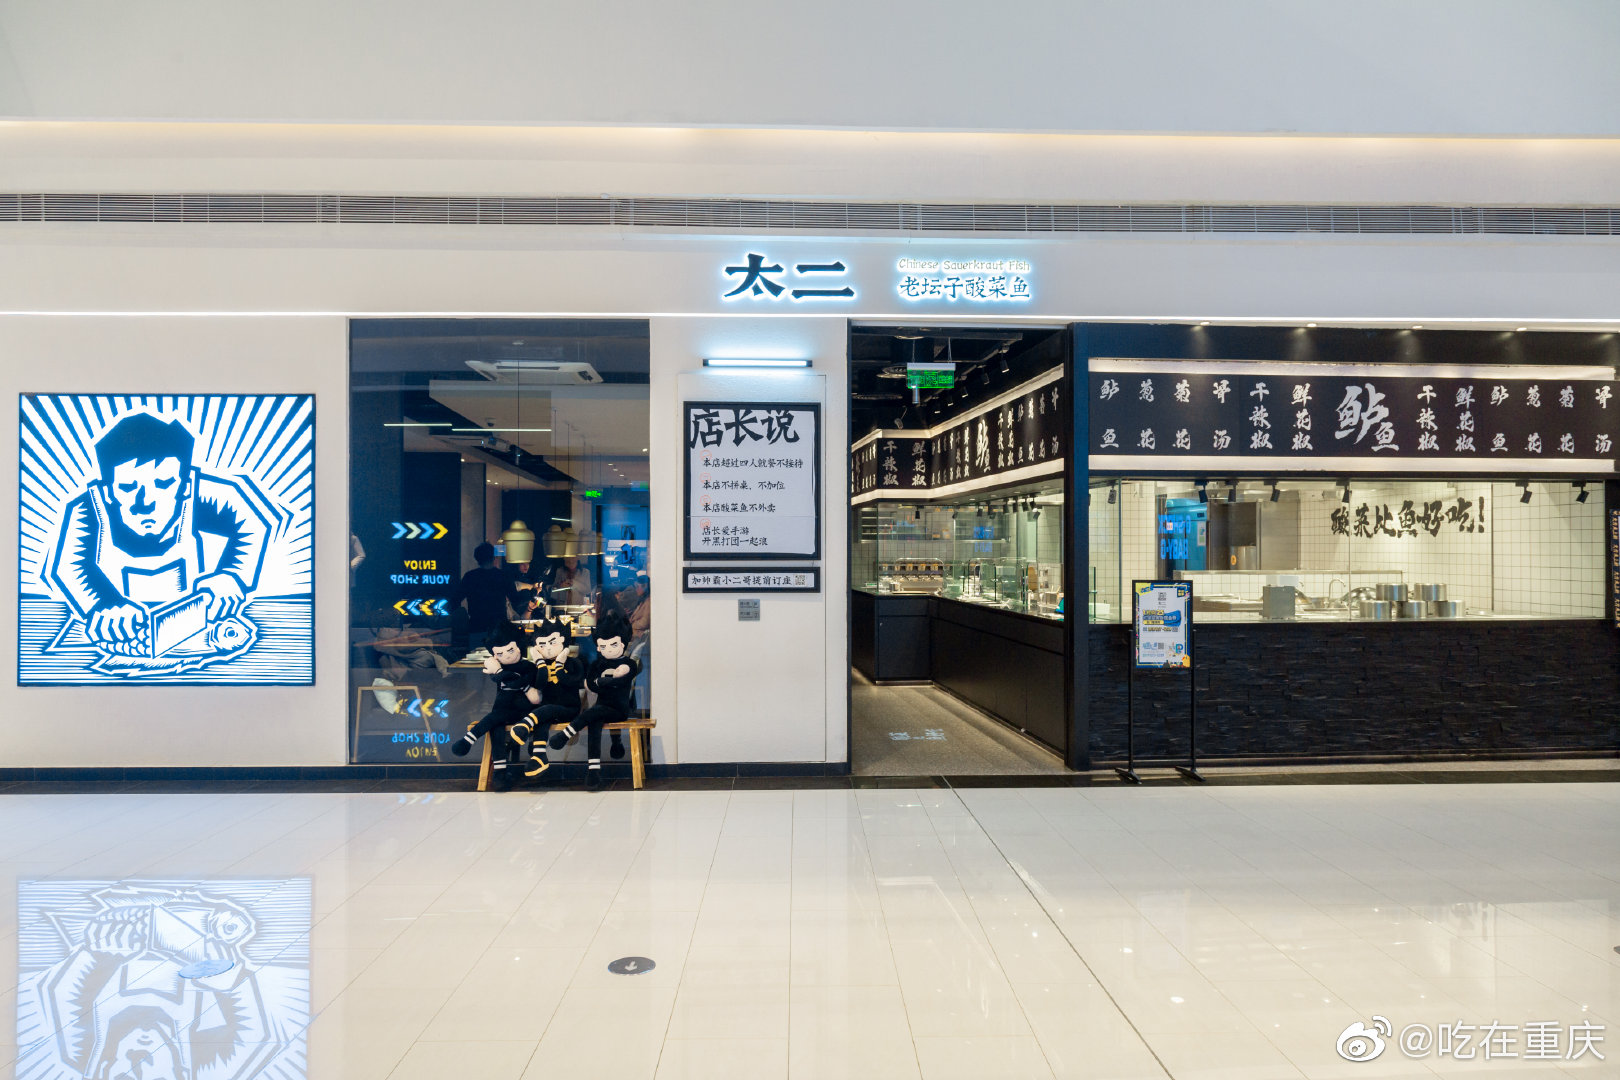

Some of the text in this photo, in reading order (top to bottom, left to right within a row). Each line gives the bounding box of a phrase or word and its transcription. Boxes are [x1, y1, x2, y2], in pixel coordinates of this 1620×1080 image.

[724, 253, 855, 299] 太二
[899, 258, 1030, 271] Chinese Sauerkraut Fish
[900, 275, 1030, 299] 老坛子酸菜鱼
[1249, 382, 1273, 450] 干辣椒
[1291, 382, 1314, 451] 鲜花椒
[1416, 385, 1440, 451] 干辣椒
[1454, 385, 1476, 452] 鲜花椒
[690, 408, 801, 449] 店长说
[702, 458, 804, 469] 本店超过四人就餐不接待
[702, 503, 776, 513] 本店酸菜鱼不外卖
[702, 526, 750, 535] 店长爱手游
[702, 537, 768, 547] 开黑打团一起浪
[691, 575, 792, 586] 加帅霸小二哥提前订座
